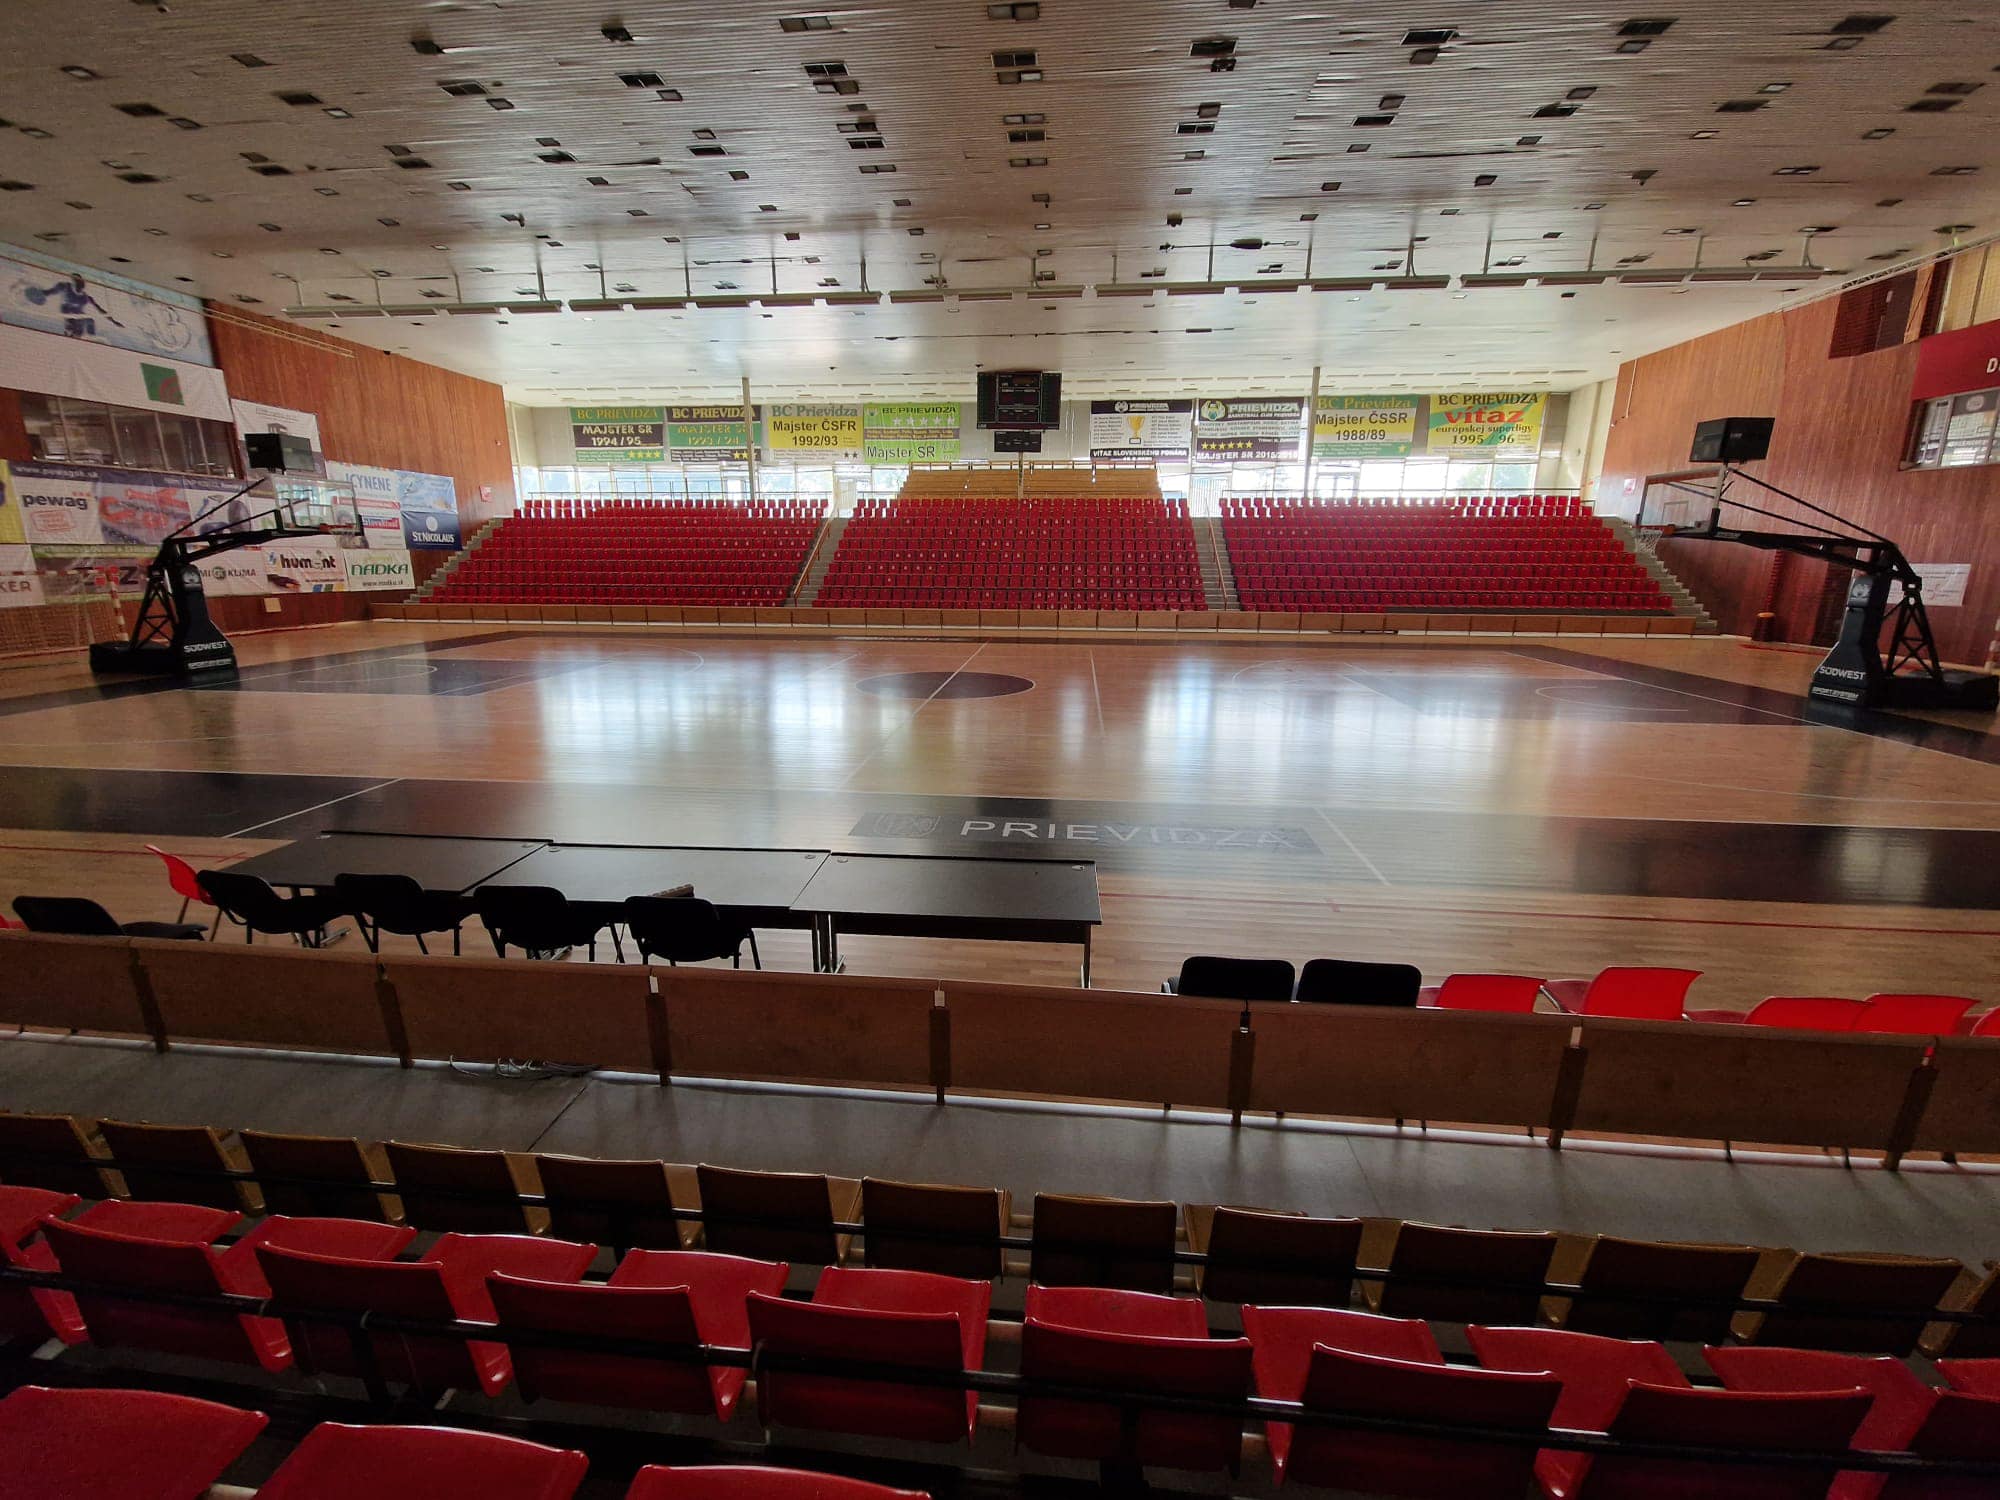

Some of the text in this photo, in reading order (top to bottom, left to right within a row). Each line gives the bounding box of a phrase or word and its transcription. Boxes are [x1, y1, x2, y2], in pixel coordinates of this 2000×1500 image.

[1317, 397, 1411, 409] BC Prievidza
[1439, 393, 1538, 405] BC PRIEVIDZA
[577, 408, 658, 419] BC PRIEVIDZA
[672, 408, 689, 418] BC
[772, 405, 858, 416] BC Prievidza
[898, 406, 956, 414] PRIEVIDZA
[1229, 403, 1300, 413] PRIEVIDZA
[1316, 411, 1408, 427] Majster ČSSR
[1444, 406, 1525, 423] víťaz
[582, 425, 653, 434] MAJSTER SR
[773, 418, 857, 433] Majster ČSFR
[1436, 423, 1534, 433] europskej superligy
[1336, 429, 1386, 440] 1988/89
[1453, 434, 1484, 444] 1995
[1500, 434, 1515, 444] 96
[592, 436, 618, 446] 1994
[627, 436, 641, 445] 95
[792, 435, 838, 446] 1992/93
[867, 446, 913, 461] Majster
[917, 446, 935, 458] SR
[1197, 451, 1239, 460] MAJSTER
[22, 495, 88, 510] pewag
[351, 564, 409, 576] NADKA
[959, 820, 1296, 849] PRIEVIDZA
